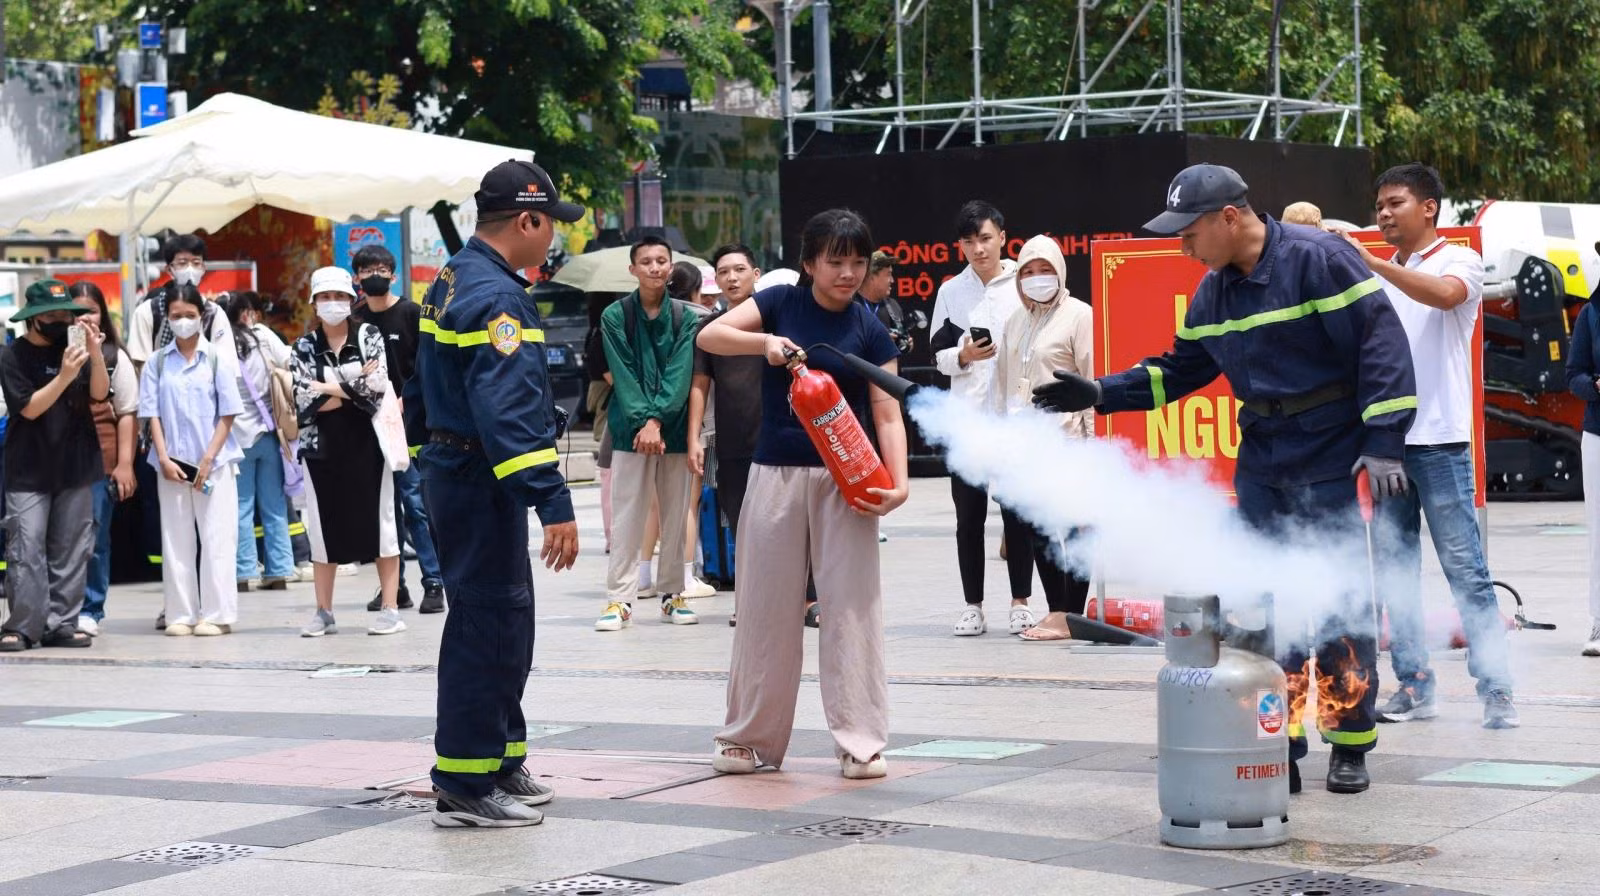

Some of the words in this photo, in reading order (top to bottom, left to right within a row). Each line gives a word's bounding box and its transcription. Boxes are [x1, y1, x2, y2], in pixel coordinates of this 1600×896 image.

[897, 272, 935, 301] BỘ
[812, 409, 837, 427] CARBON
[1236, 763, 1280, 780] PETIMEX
